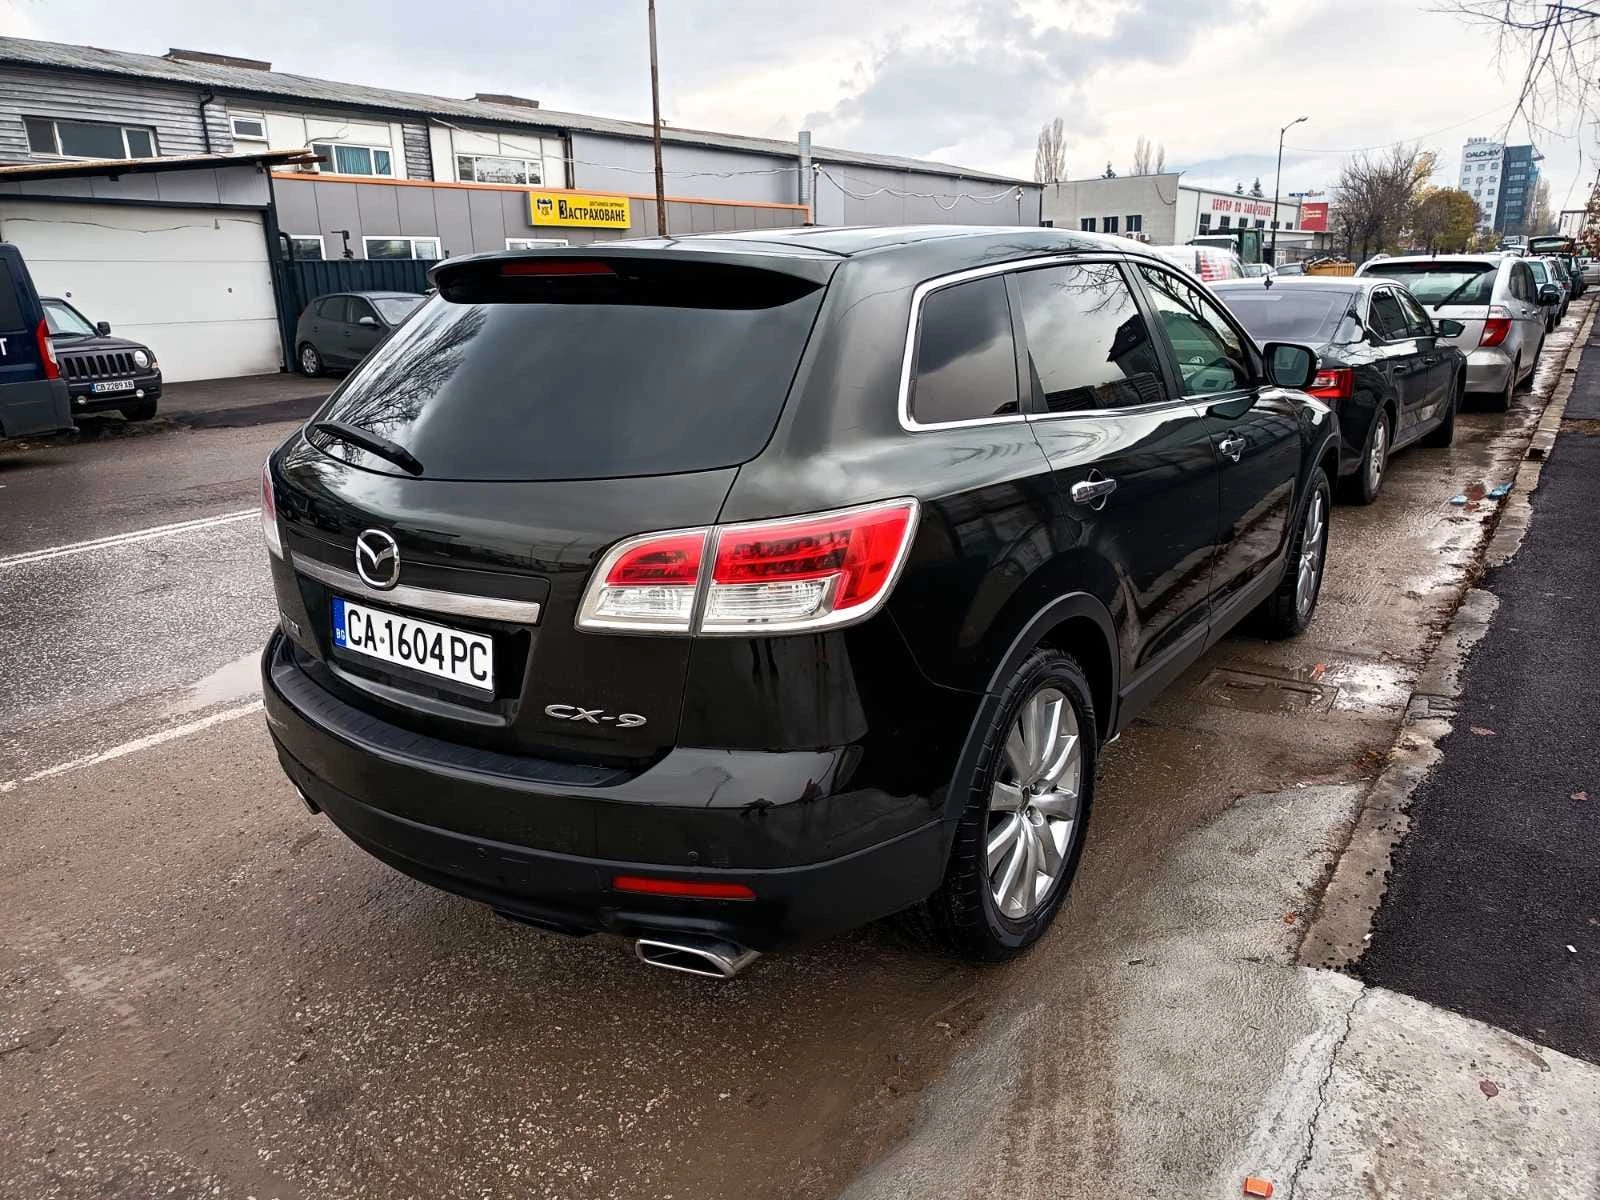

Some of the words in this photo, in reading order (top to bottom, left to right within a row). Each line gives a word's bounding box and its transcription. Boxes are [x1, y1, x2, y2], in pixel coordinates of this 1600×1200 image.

[558, 200, 625, 221] ЗАСТРАХОВАНЕ
[335, 628, 346, 641] BG
[544, 704, 647, 728] CX-9
